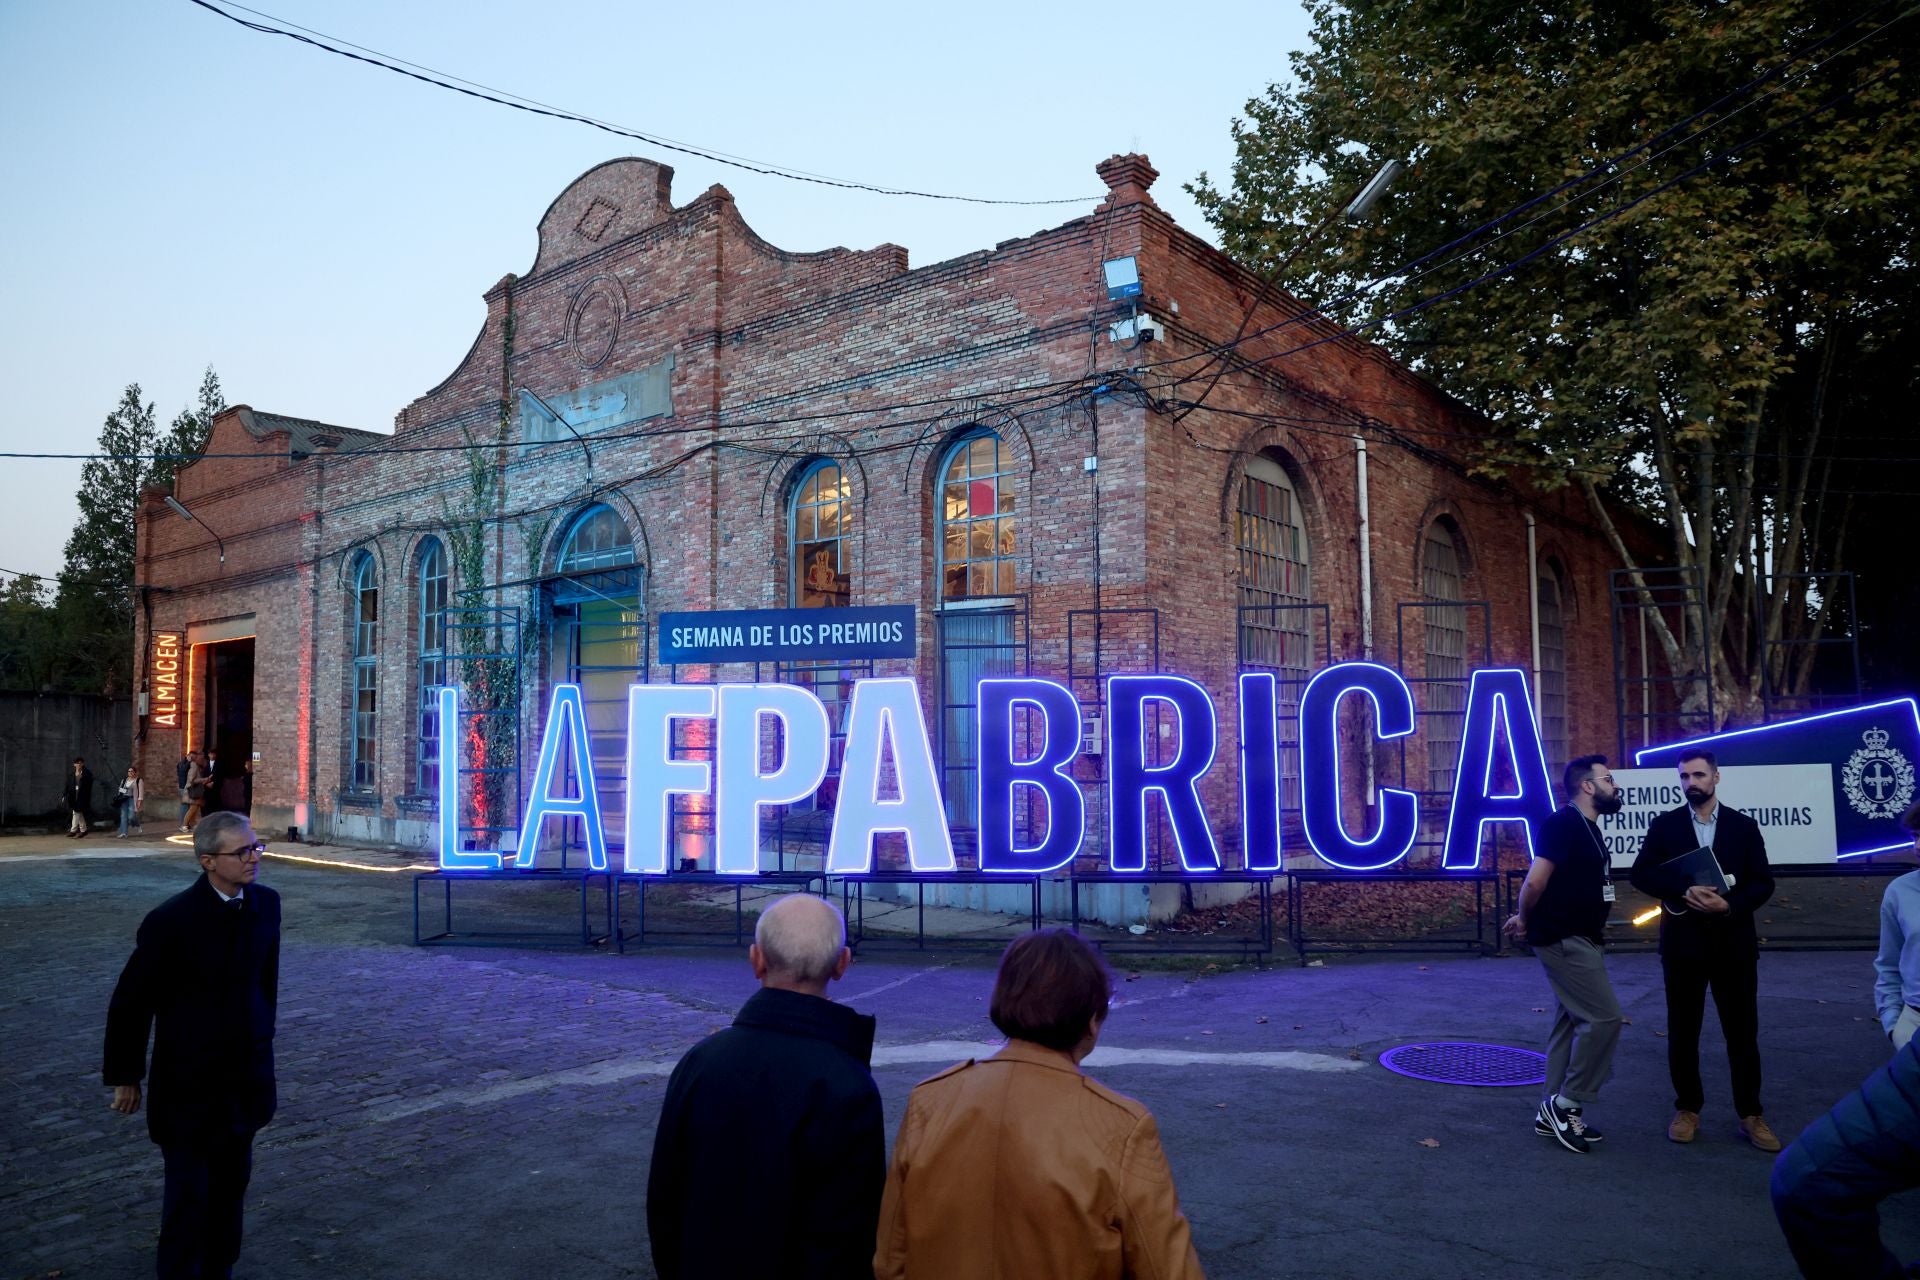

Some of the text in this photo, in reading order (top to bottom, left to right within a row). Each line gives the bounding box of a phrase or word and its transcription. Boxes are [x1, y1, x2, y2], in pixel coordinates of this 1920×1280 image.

[671, 621, 903, 648] SEMANA DE LOS PREMIOS
[155, 634, 178, 725] ALMACEN
[1617, 785, 1682, 806] REMIOS
[1603, 806, 1812, 830] PRINC TURIAS
